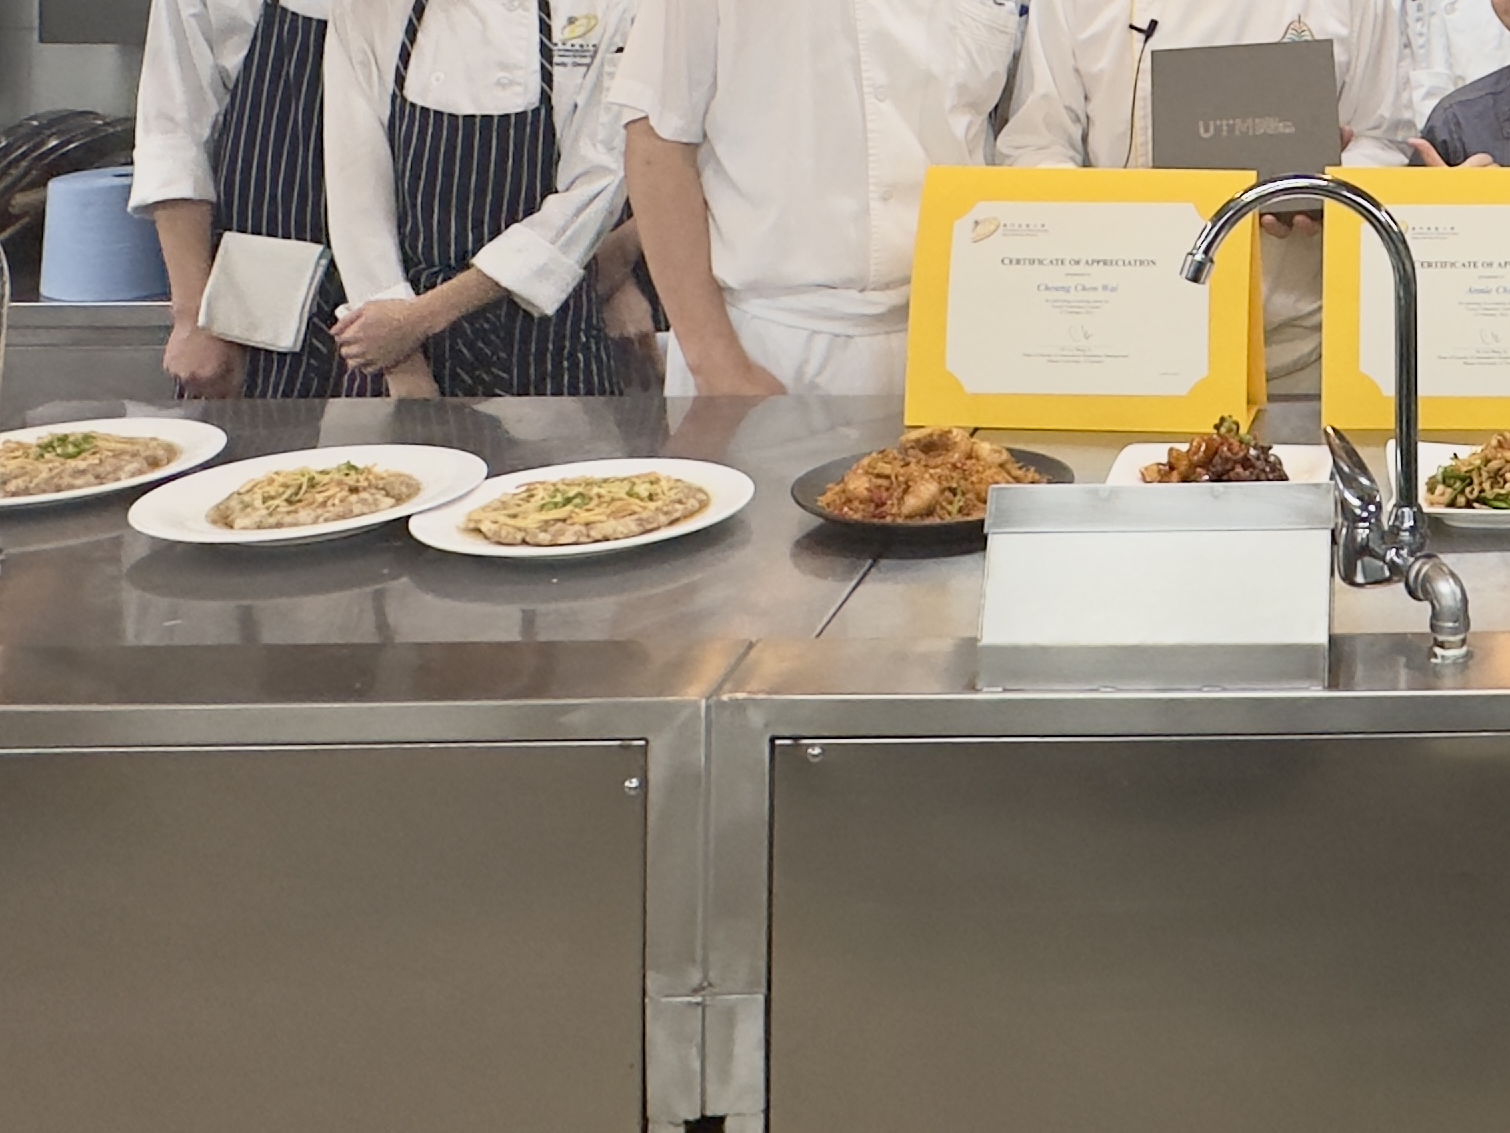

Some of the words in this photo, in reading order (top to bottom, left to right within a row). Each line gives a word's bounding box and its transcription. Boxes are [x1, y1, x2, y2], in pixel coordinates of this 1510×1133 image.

[1000, 256, 1066, 267] CERTIFICATE
[1069, 258, 1081, 267] OF
[1084, 258, 1157, 268] APPRECIATION
[1481, 260, 1494, 269] OF
